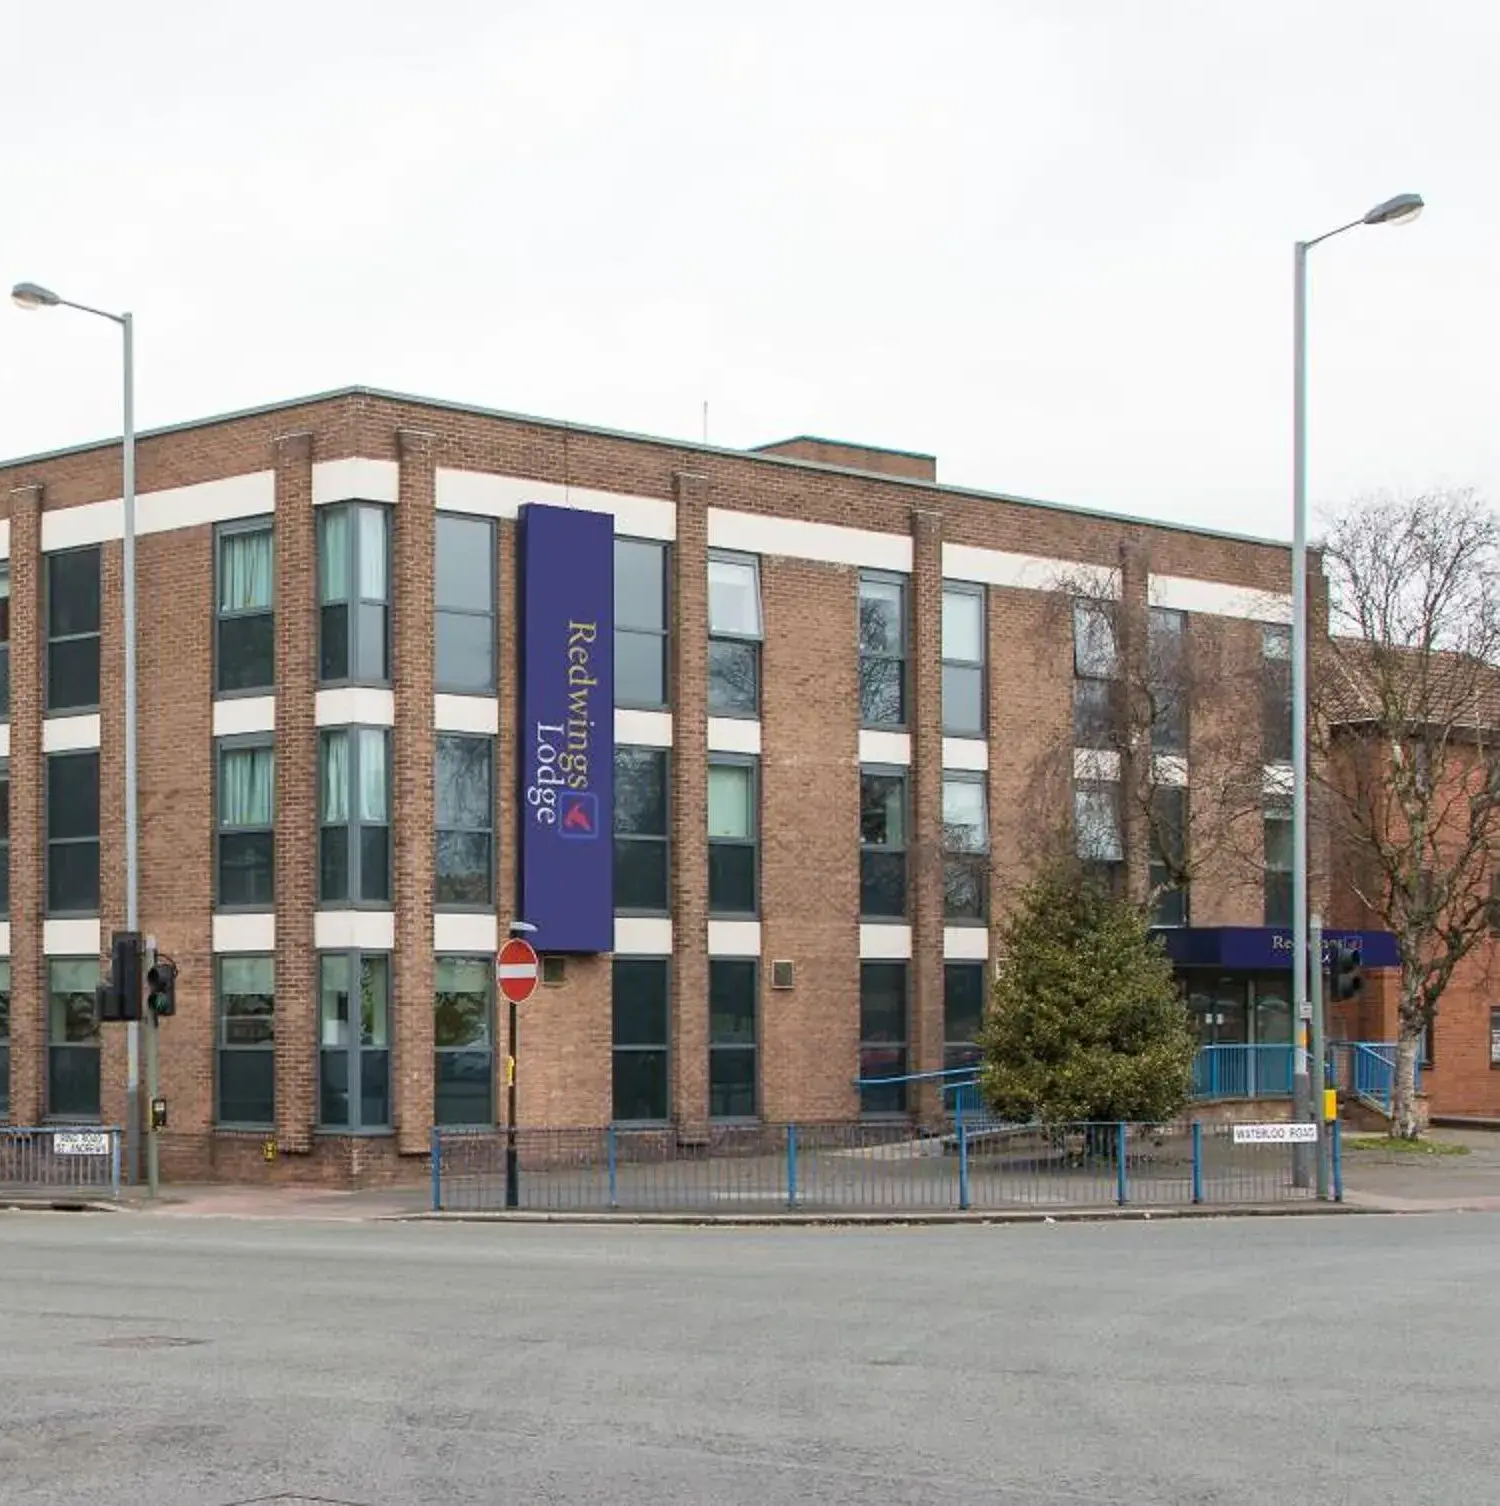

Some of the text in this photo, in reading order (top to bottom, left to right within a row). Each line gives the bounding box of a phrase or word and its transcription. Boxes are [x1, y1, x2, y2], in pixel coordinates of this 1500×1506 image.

[558, 619, 597, 789] Redwings
[527, 721, 565, 824] Lodge
[1236, 1126, 1315, 1139] WATERLOO ROAD
